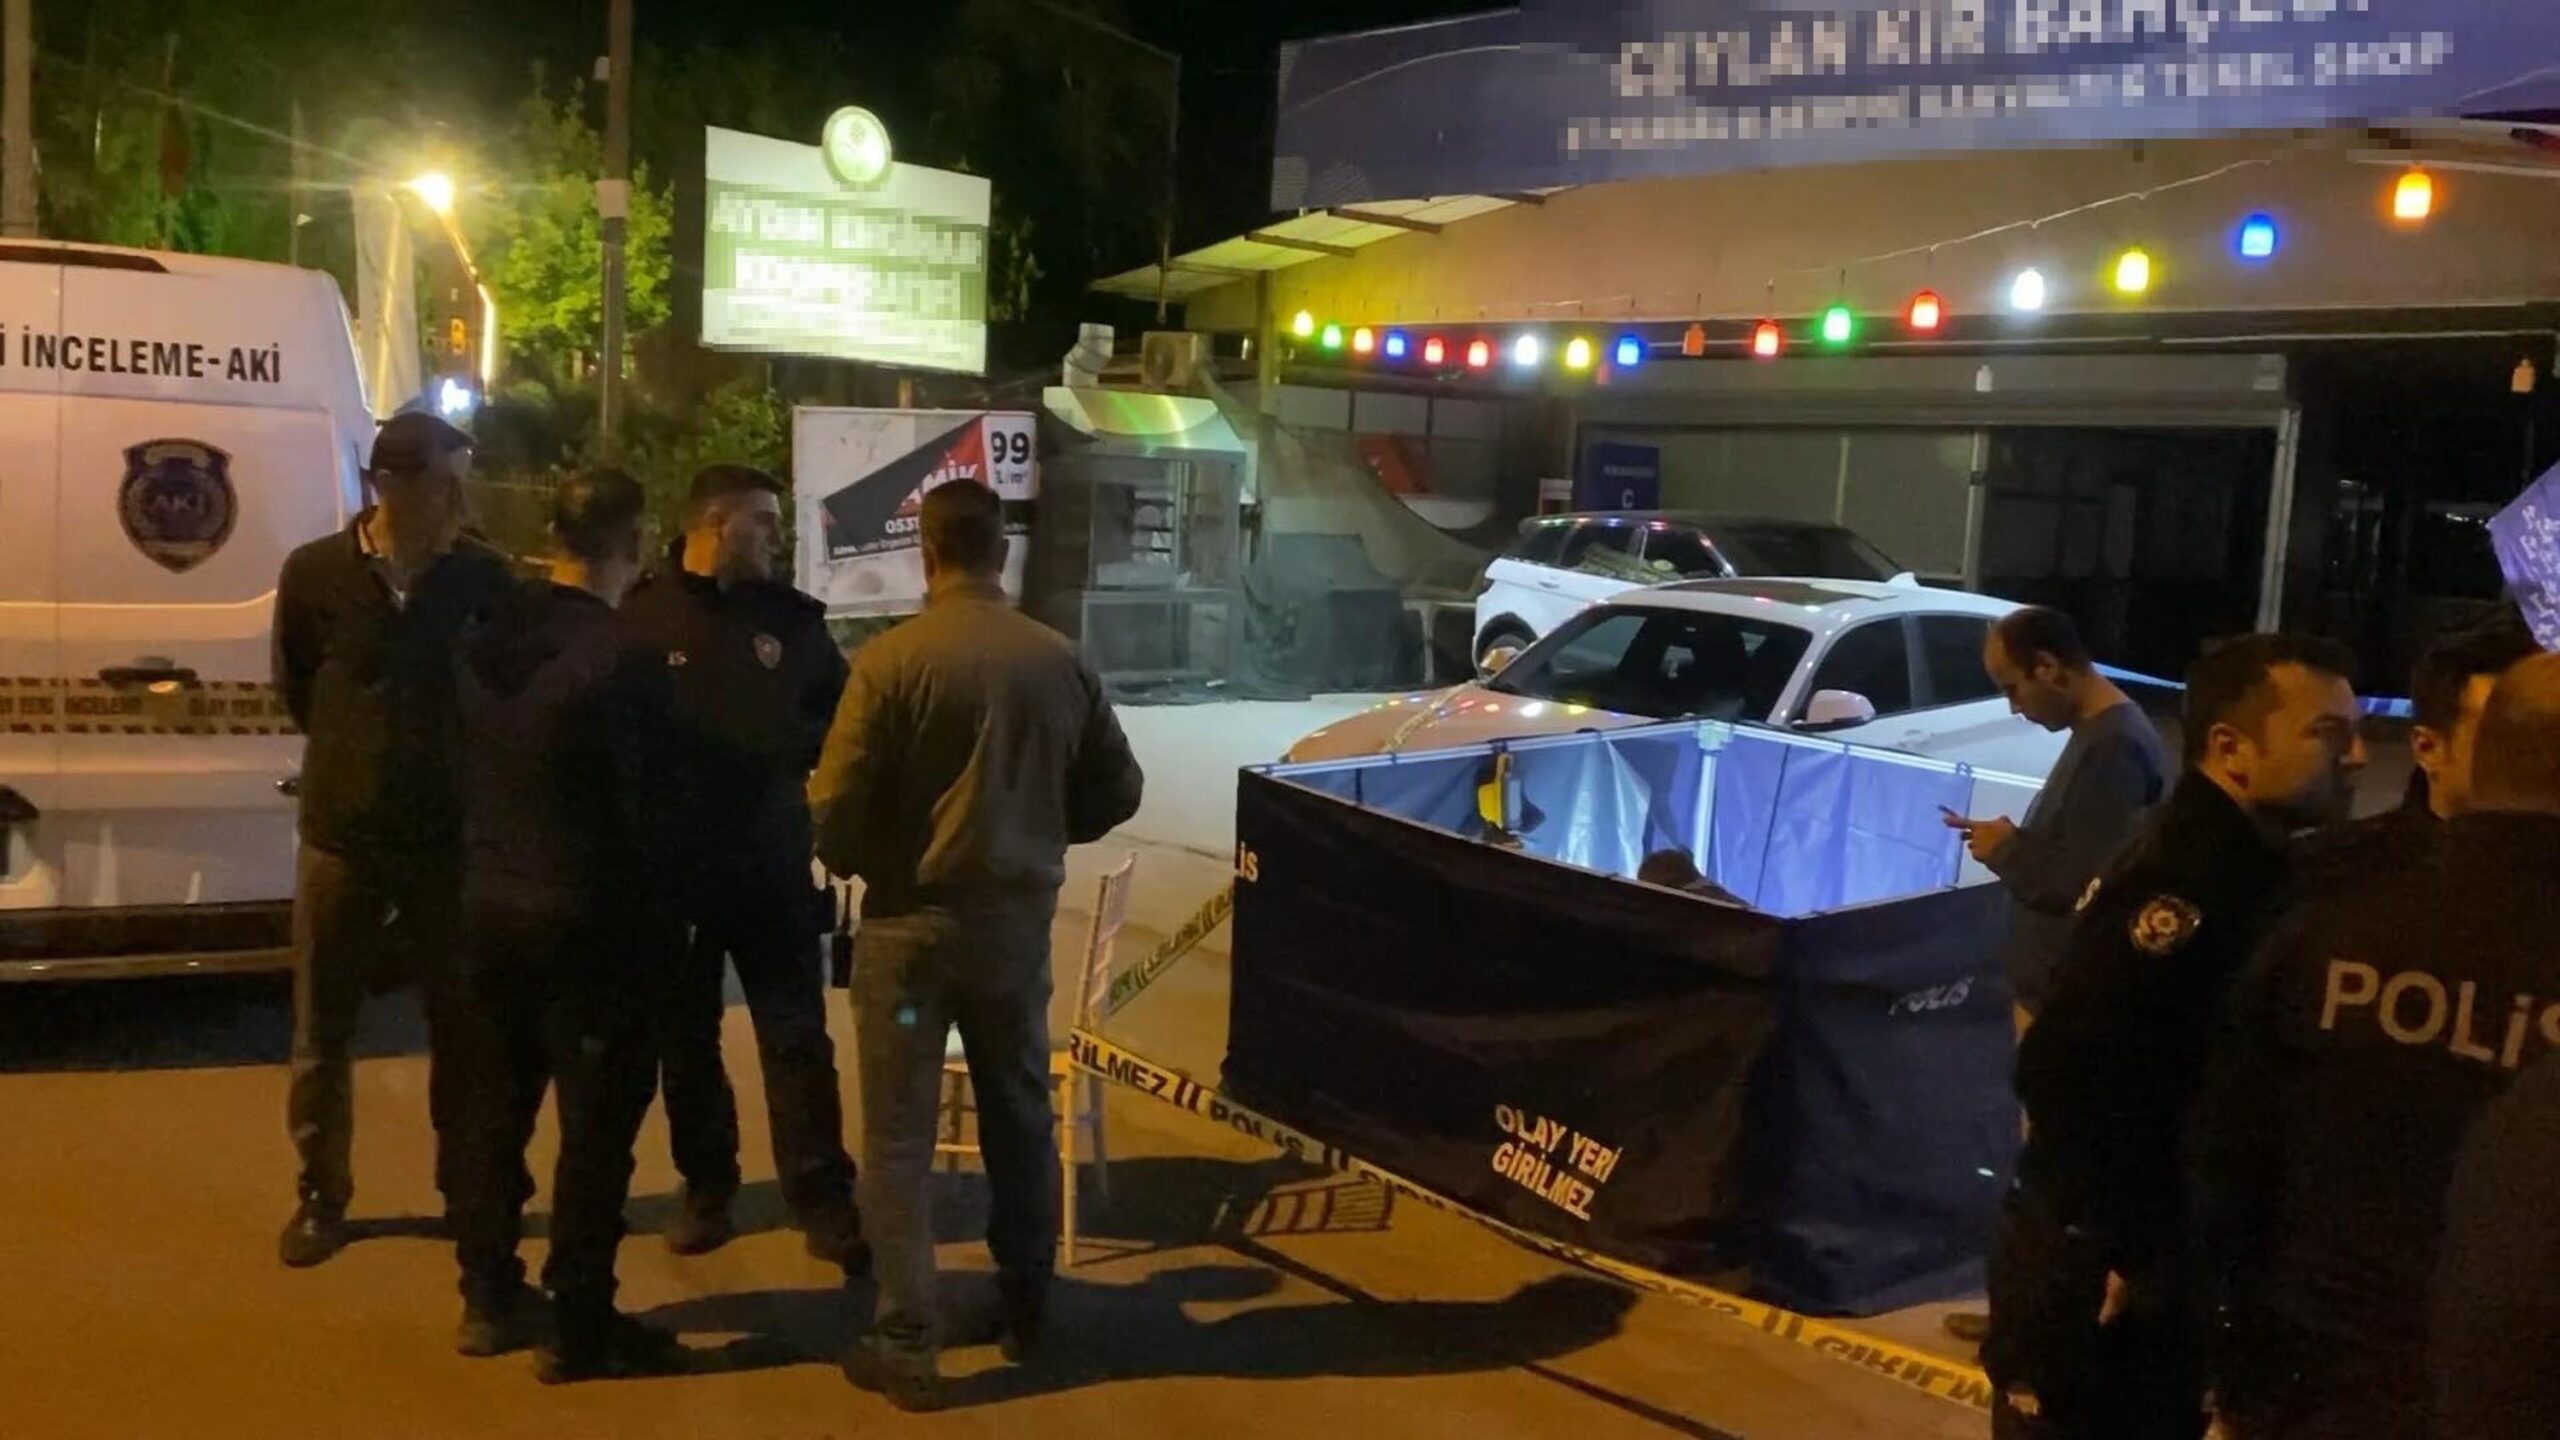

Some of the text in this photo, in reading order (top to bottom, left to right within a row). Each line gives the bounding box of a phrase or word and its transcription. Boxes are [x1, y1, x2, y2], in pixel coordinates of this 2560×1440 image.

[990, 431, 1030, 464] 99
[1492, 1141, 1596, 1222] GİRİLMEZ
[1494, 1103, 1623, 1184] OLAY YERİ
